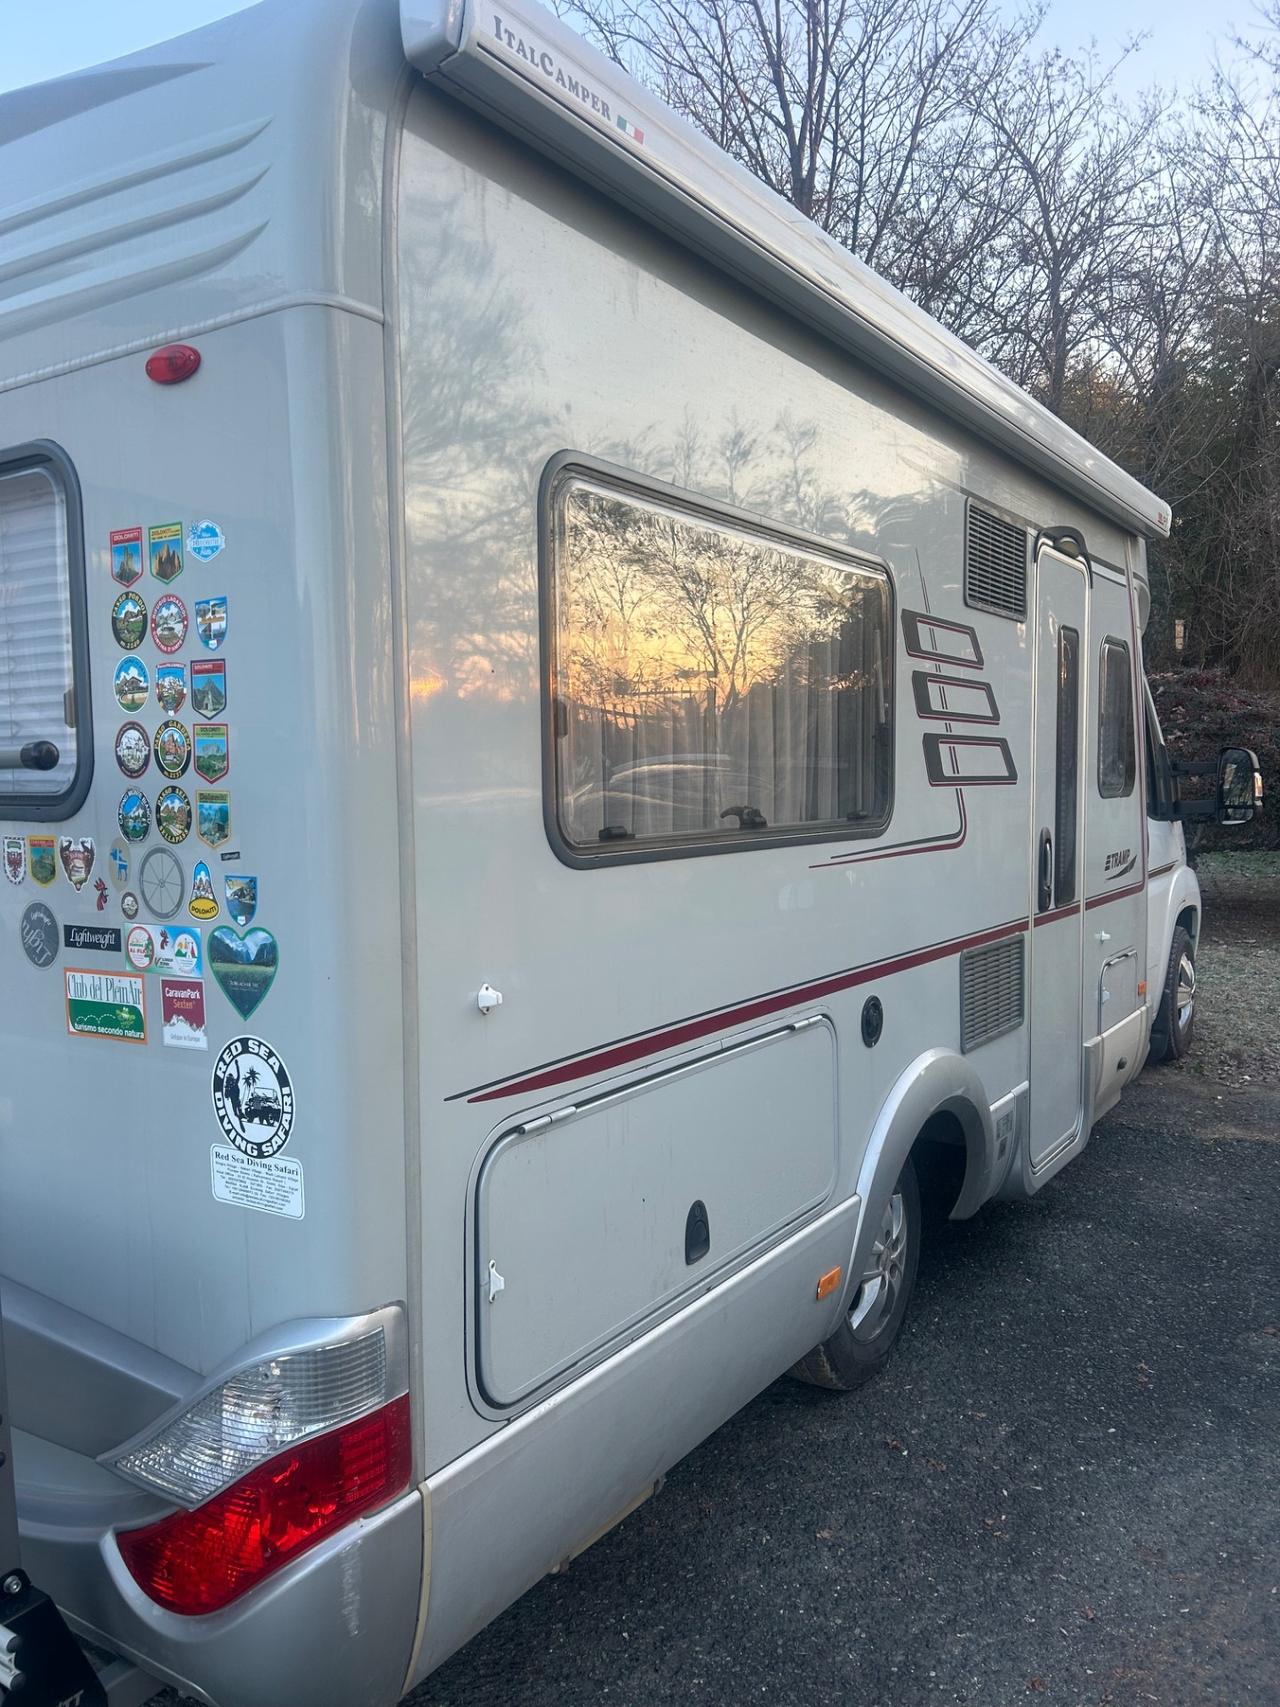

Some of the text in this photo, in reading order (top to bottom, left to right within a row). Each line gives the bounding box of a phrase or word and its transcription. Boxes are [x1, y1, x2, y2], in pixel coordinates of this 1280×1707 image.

[175, 787, 191, 810] SELLA
[191, 905, 217, 914] DOLOMITI
[70, 928, 116, 949] Lightweight
[68, 973, 88, 999] Club
[90, 975, 102, 1001] del
[165, 987, 200, 999] CaravanPark
[74, 1022, 144, 1039] turismo secondo natura
[216, 1039, 280, 1080] RED SEA
[214, 1086, 292, 1157] DIVING SAFARI
[215, 1151, 299, 1176] Red Sea Diving Safari
